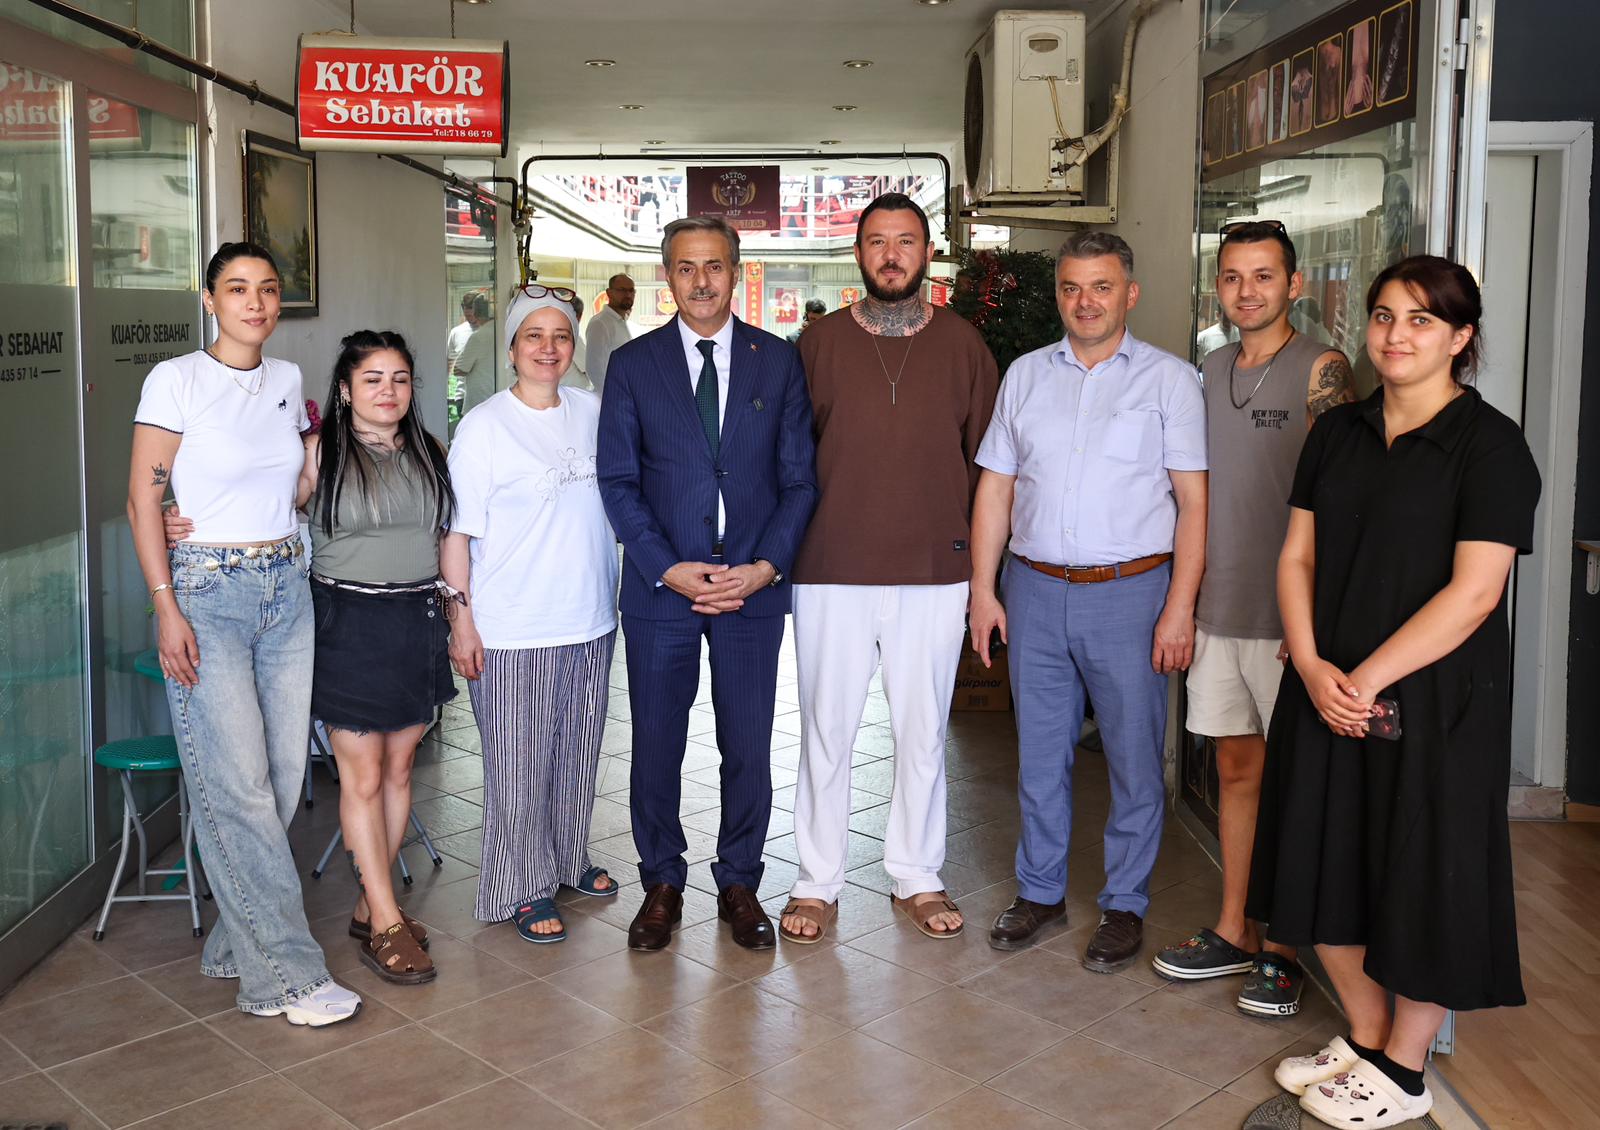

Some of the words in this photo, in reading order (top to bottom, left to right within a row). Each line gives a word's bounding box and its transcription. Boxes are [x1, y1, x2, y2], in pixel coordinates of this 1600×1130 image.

[314, 55, 484, 97] KUAFÖR
[326, 97, 471, 128] Sebahat
[467, 129, 479, 138] 66
[481, 130, 493, 138] 79
[720, 171, 747, 181] TATTOO
[111, 319, 151, 345] KUAFÖR
[153, 323, 190, 343] SEBAHAT
[8, 332, 63, 356] SEBAHAT
[133, 353, 148, 365] 0533
[17, 367, 26, 381] 57
[29, 366, 39, 380] 14
[1251, 409, 1267, 420] NEW
[1268, 409, 1289, 421] YORK
[1255, 418, 1282, 430] ATHLETIC
